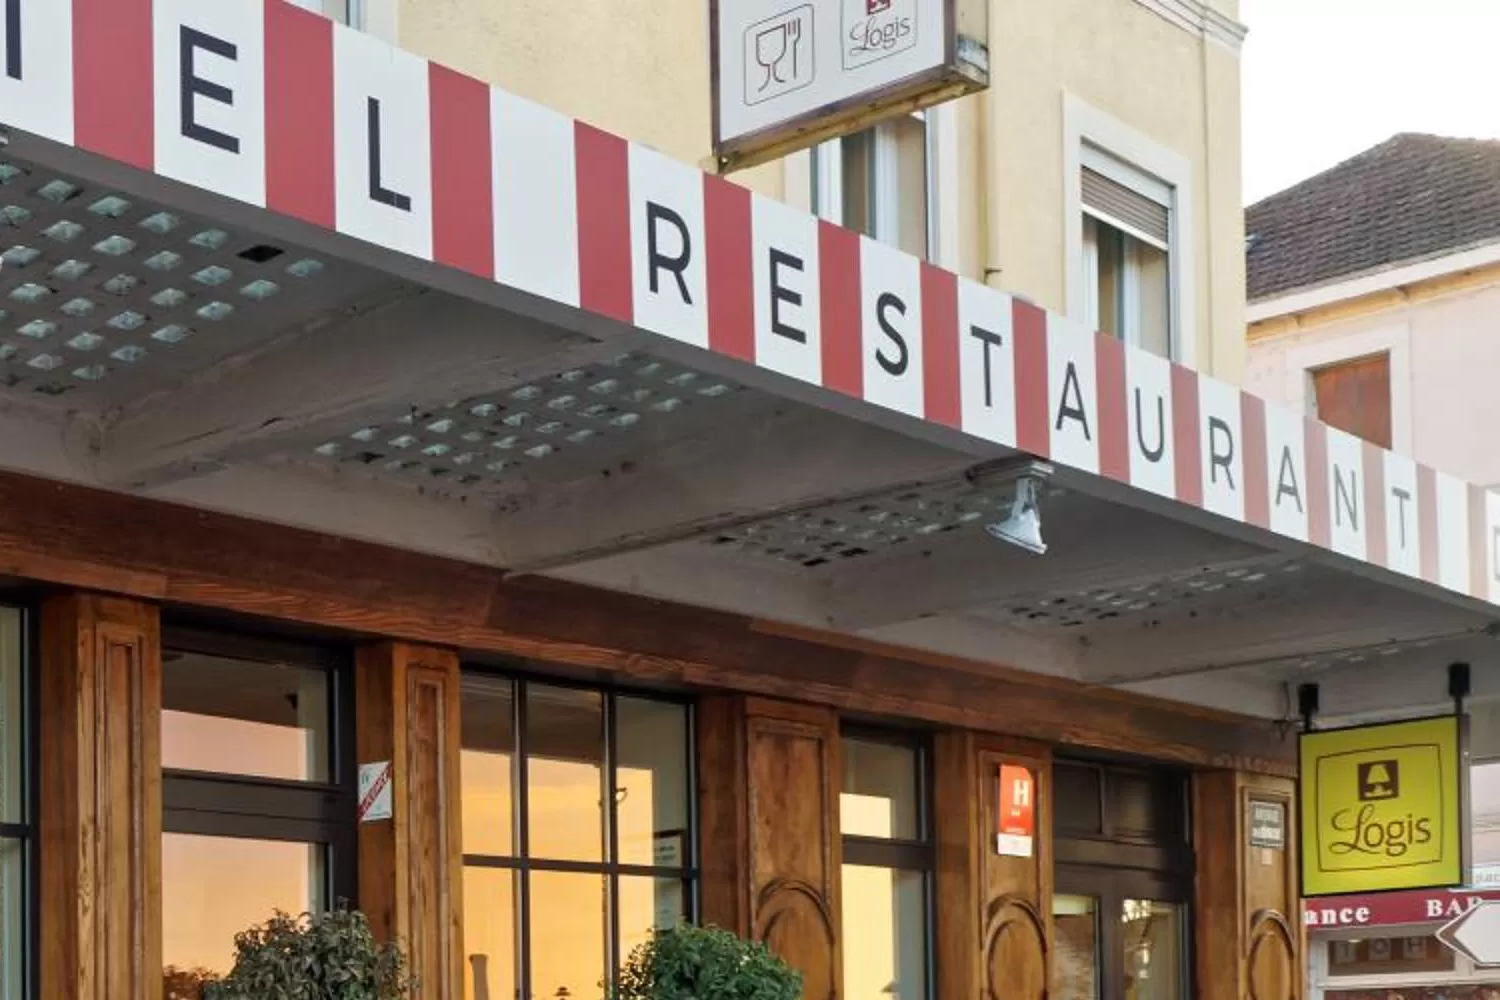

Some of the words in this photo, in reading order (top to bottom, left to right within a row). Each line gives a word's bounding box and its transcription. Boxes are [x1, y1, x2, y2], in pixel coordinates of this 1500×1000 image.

[849, 16, 911, 56] Logis
[647, 202, 1412, 549] RESTAURANT
[1328, 803, 1432, 857] Logis
